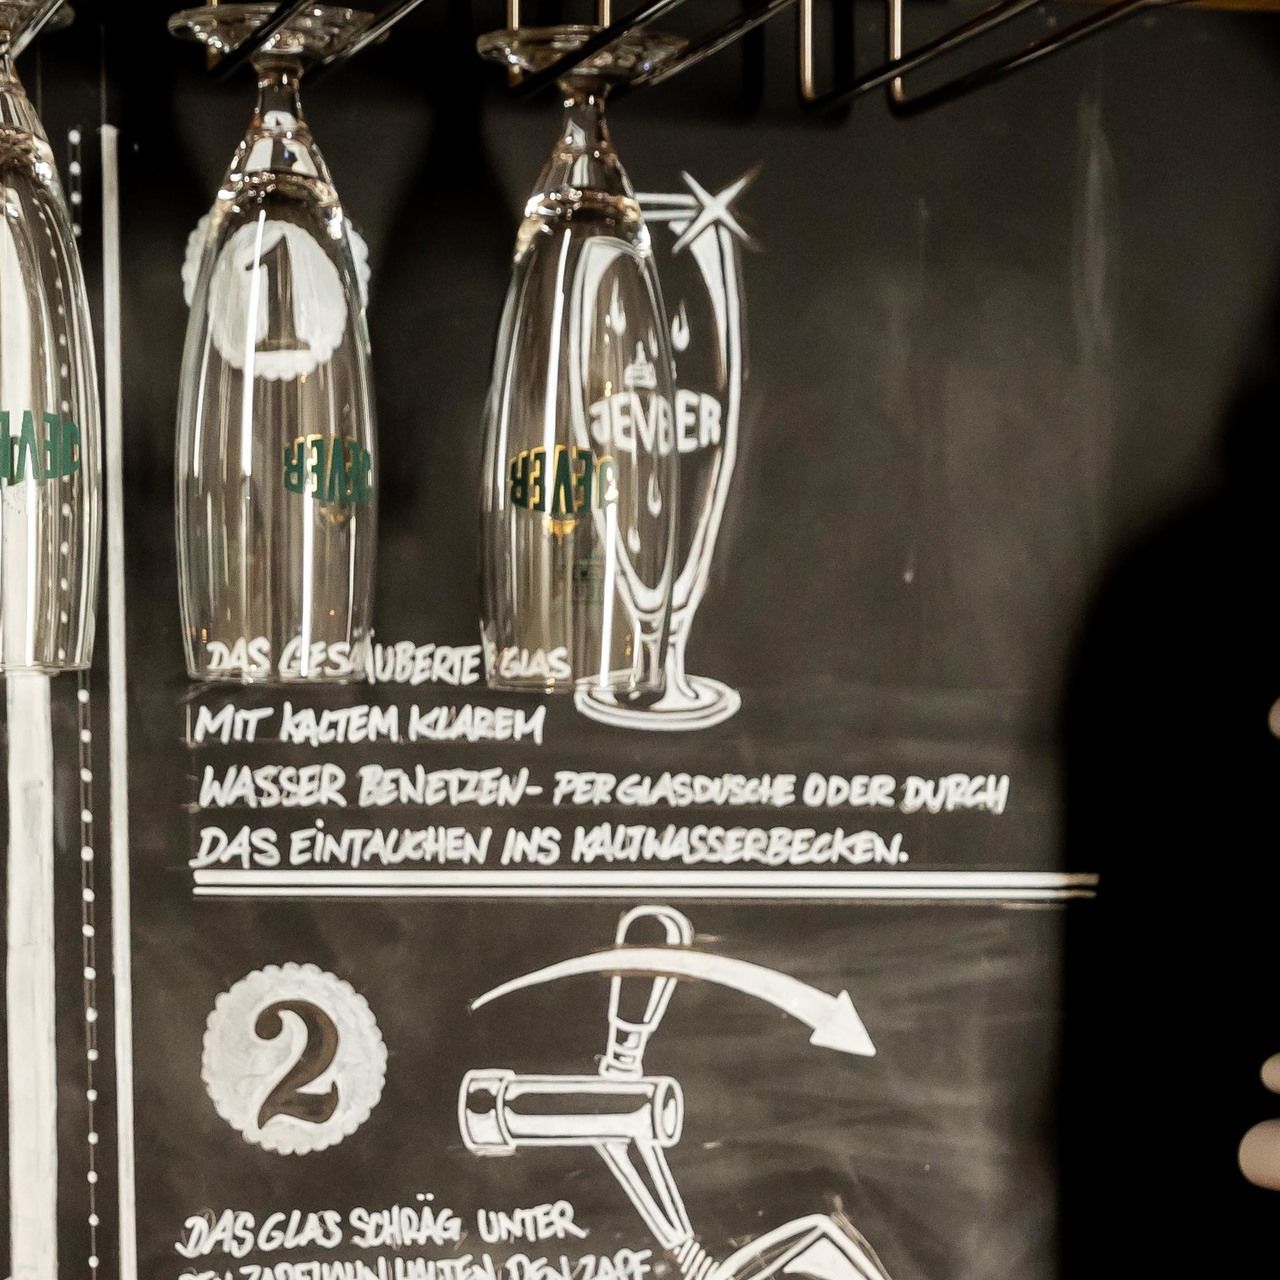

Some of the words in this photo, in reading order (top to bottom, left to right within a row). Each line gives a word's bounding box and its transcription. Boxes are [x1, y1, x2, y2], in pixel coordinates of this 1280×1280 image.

[206, 637, 272, 674] DAS
[500, 645, 571, 680] GLAS
[194, 703, 275, 745] MIT
[279, 701, 401, 747] KALTEM
[409, 703, 547, 746] KLAREM
[198, 763, 347, 809] WASSER
[358, 763, 543, 807] BENETZEN-
[553, 770, 614, 807] PER
[616, 771, 797, 807] GLASDUSCHE
[803, 772, 895, 808] ODER
[900, 772, 1011, 815] DURCH
[188, 825, 280, 869] DAS
[289, 818, 492, 868] EINTAUCHEN
[500, 825, 562, 866] INS
[571, 822, 909, 866] KALTWASSERBECKEN.
[254, 1000, 339, 1129] 2
[176, 1210, 254, 1259] DAS
[257, 1208, 342, 1250] GLAS
[350, 1192, 462, 1249] SCHRÄG
[477, 1199, 590, 1244] UNTER
